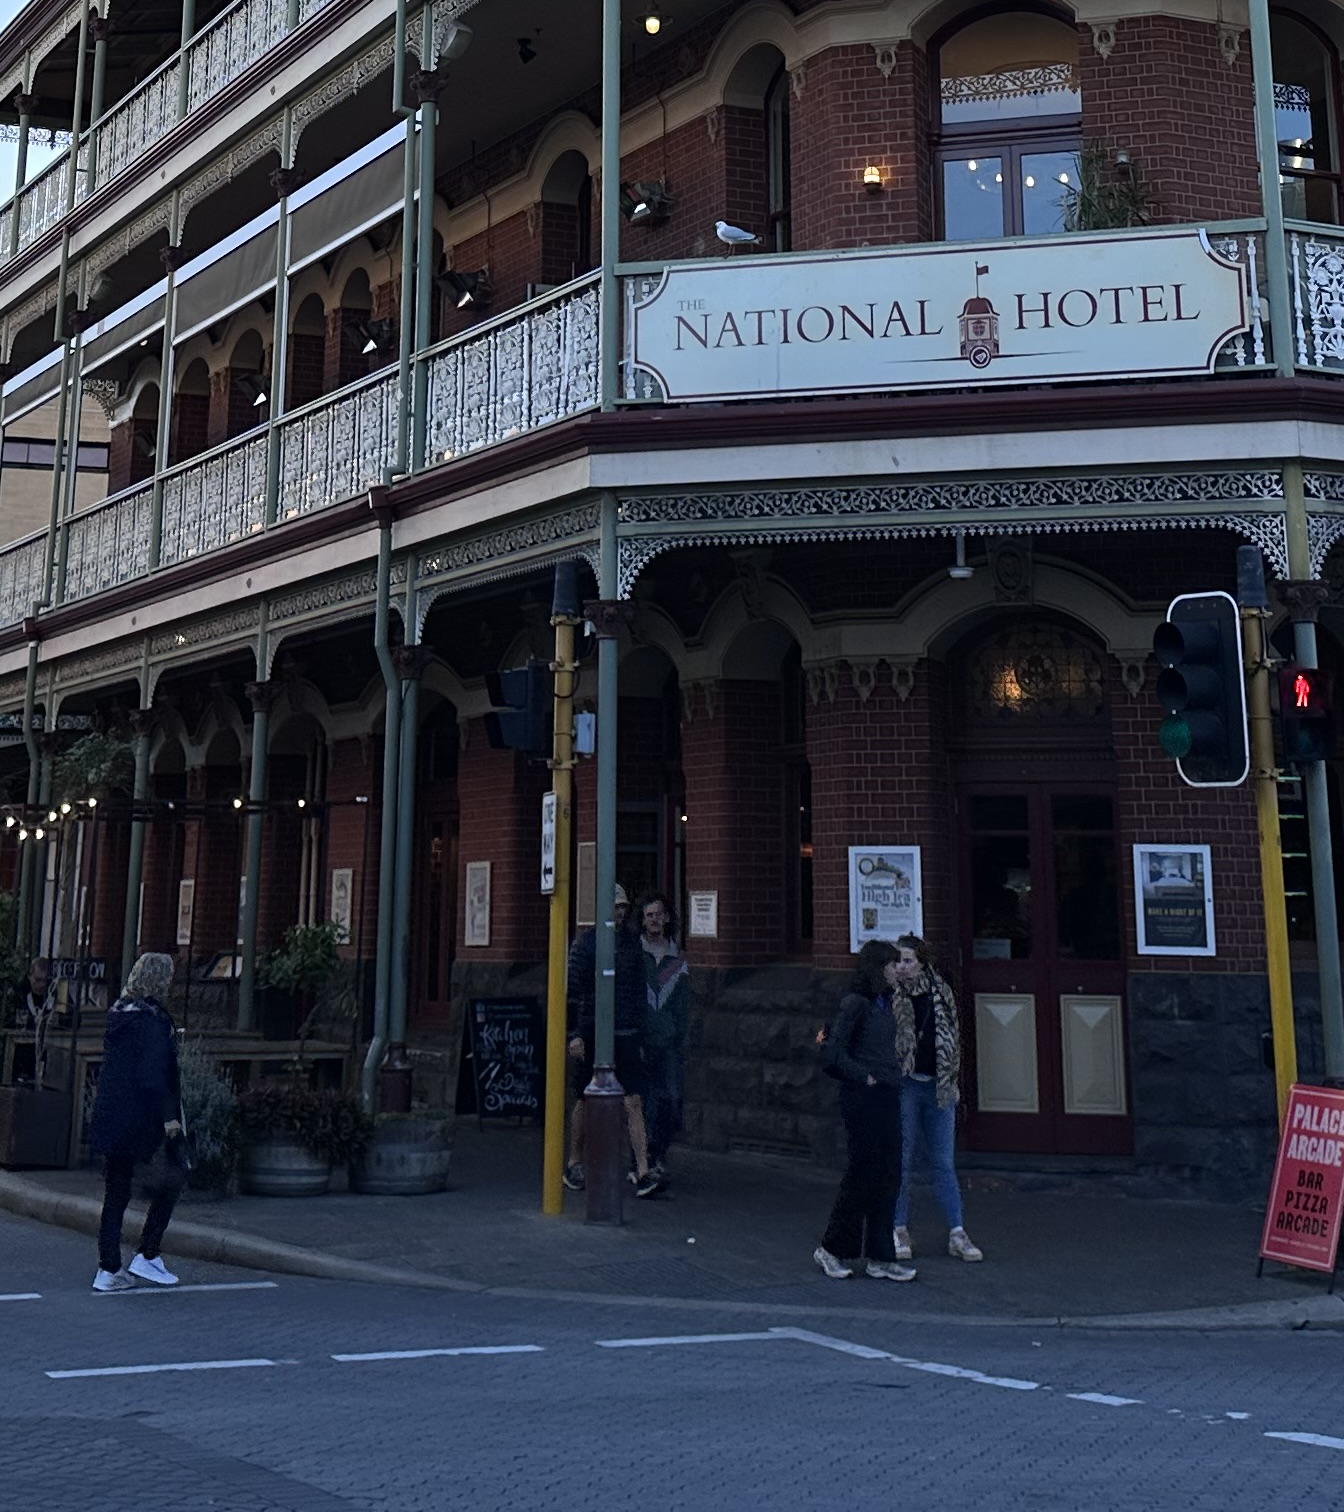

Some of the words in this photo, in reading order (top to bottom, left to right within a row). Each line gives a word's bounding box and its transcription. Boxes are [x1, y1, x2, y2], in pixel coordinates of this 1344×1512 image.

[674, 300, 944, 351] NATIONAL
[1014, 284, 1202, 330] HOTEL
[678, 299, 706, 311] THE
[861, 890, 890, 905] High
[1287, 1133, 1344, 1167] ARCADE
[1297, 1170, 1324, 1191] BAR
[1284, 1190, 1329, 1215] PIZZA
[1276, 1211, 1330, 1238] ARCADE
